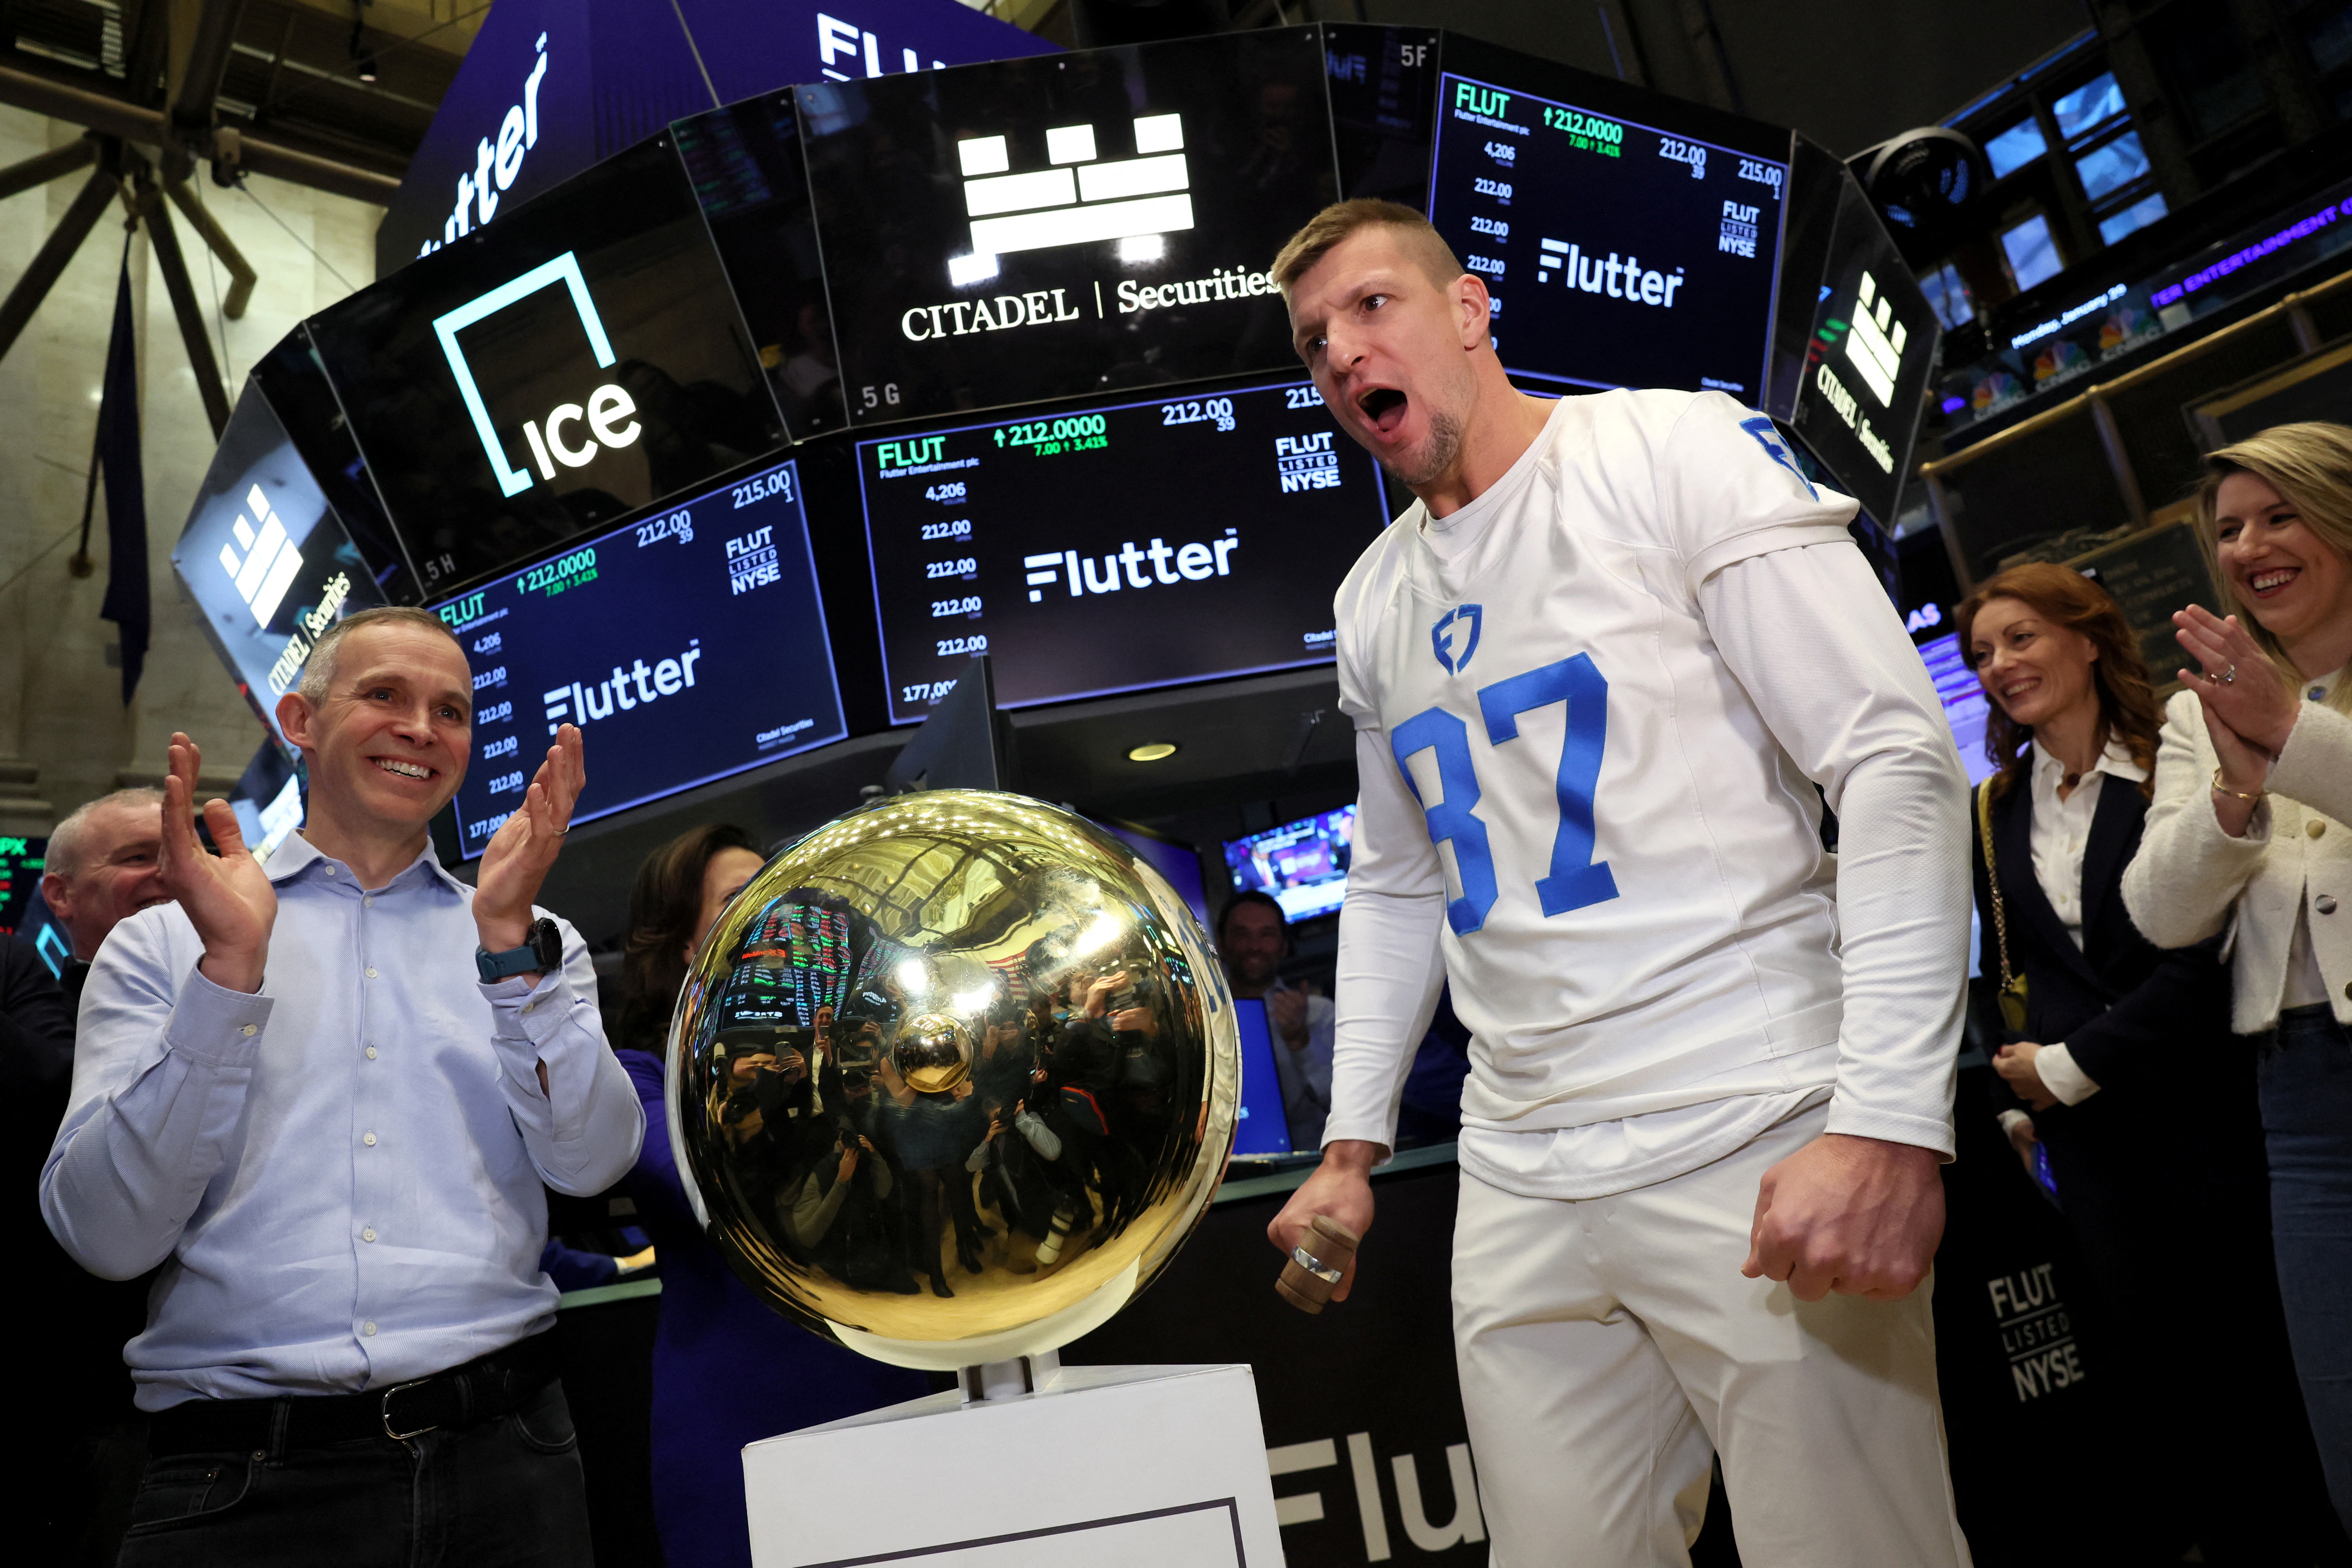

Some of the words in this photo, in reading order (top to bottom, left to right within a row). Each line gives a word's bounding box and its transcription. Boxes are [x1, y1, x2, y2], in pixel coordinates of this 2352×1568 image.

[1456, 82, 1510, 118] FLUT
[1554, 109, 1623, 145] 212.0000
[417, 51, 546, 259] tter
[1484, 141, 1515, 161] 4,206
[1659, 138, 1706, 166] 212.00
[1738, 159, 1782, 187] 215.00
[1474, 177, 1512, 198] 212.00
[1722, 200, 1760, 224] FLUT
[1471, 216, 1508, 236] 212.00
[1720, 222, 1757, 239] LISTED
[1719, 235, 1756, 258] NYSE
[1467, 255, 1505, 274] 212.00
[1538, 238, 1684, 308] Flutter
[902, 288, 1079, 343] CITADEL
[1118, 266, 1282, 314] Securities
[1818, 364, 1857, 429] CITADEL
[1161, 398, 1233, 426] 212.00
[1217, 416, 1235, 432] 39
[1009, 414, 1106, 446] 212.0000
[878, 436, 946, 469] FLUT
[1034, 442, 1060, 456] 7.00
[1074, 435, 1108, 451] 3.41%
[1276, 432, 1333, 456] FLUT
[880, 466, 907, 479] Flutter
[908, 459, 965, 475] Entertainment
[1279, 456, 1338, 471] LISTED
[732, 470, 791, 509] 215.00
[925, 482, 966, 501] 4,206
[1280, 470, 1341, 493] NYSE
[636, 510, 691, 548] 212.00
[679, 527, 694, 544] 39
[921, 520, 971, 540] 212.00
[725, 525, 773, 559] FLUT
[527, 547, 597, 592] 212.0000
[728, 549, 778, 575] LISTED
[926, 557, 976, 579] 212.00
[1024, 537, 1239, 603] Flutter
[731, 562, 781, 595] NYSE
[439, 592, 485, 626] FLUT
[931, 596, 982, 617] 212.00
[473, 632, 502, 653] 4,206
[936, 635, 988, 657] 212.00
[473, 666, 507, 691] 212.00
[544, 647, 701, 735] Flutter
[903, 679, 957, 702] 177,00
[478, 701, 512, 725] 212.00
[483, 735, 518, 760] 212.00
[489, 770, 524, 795] 212.00
[1391, 651, 1620, 937] 87
[1988, 1263, 2055, 1319] FLUT
[2002, 1312, 2070, 1353] LISTED
[2012, 1343, 2085, 1403] NYSE
